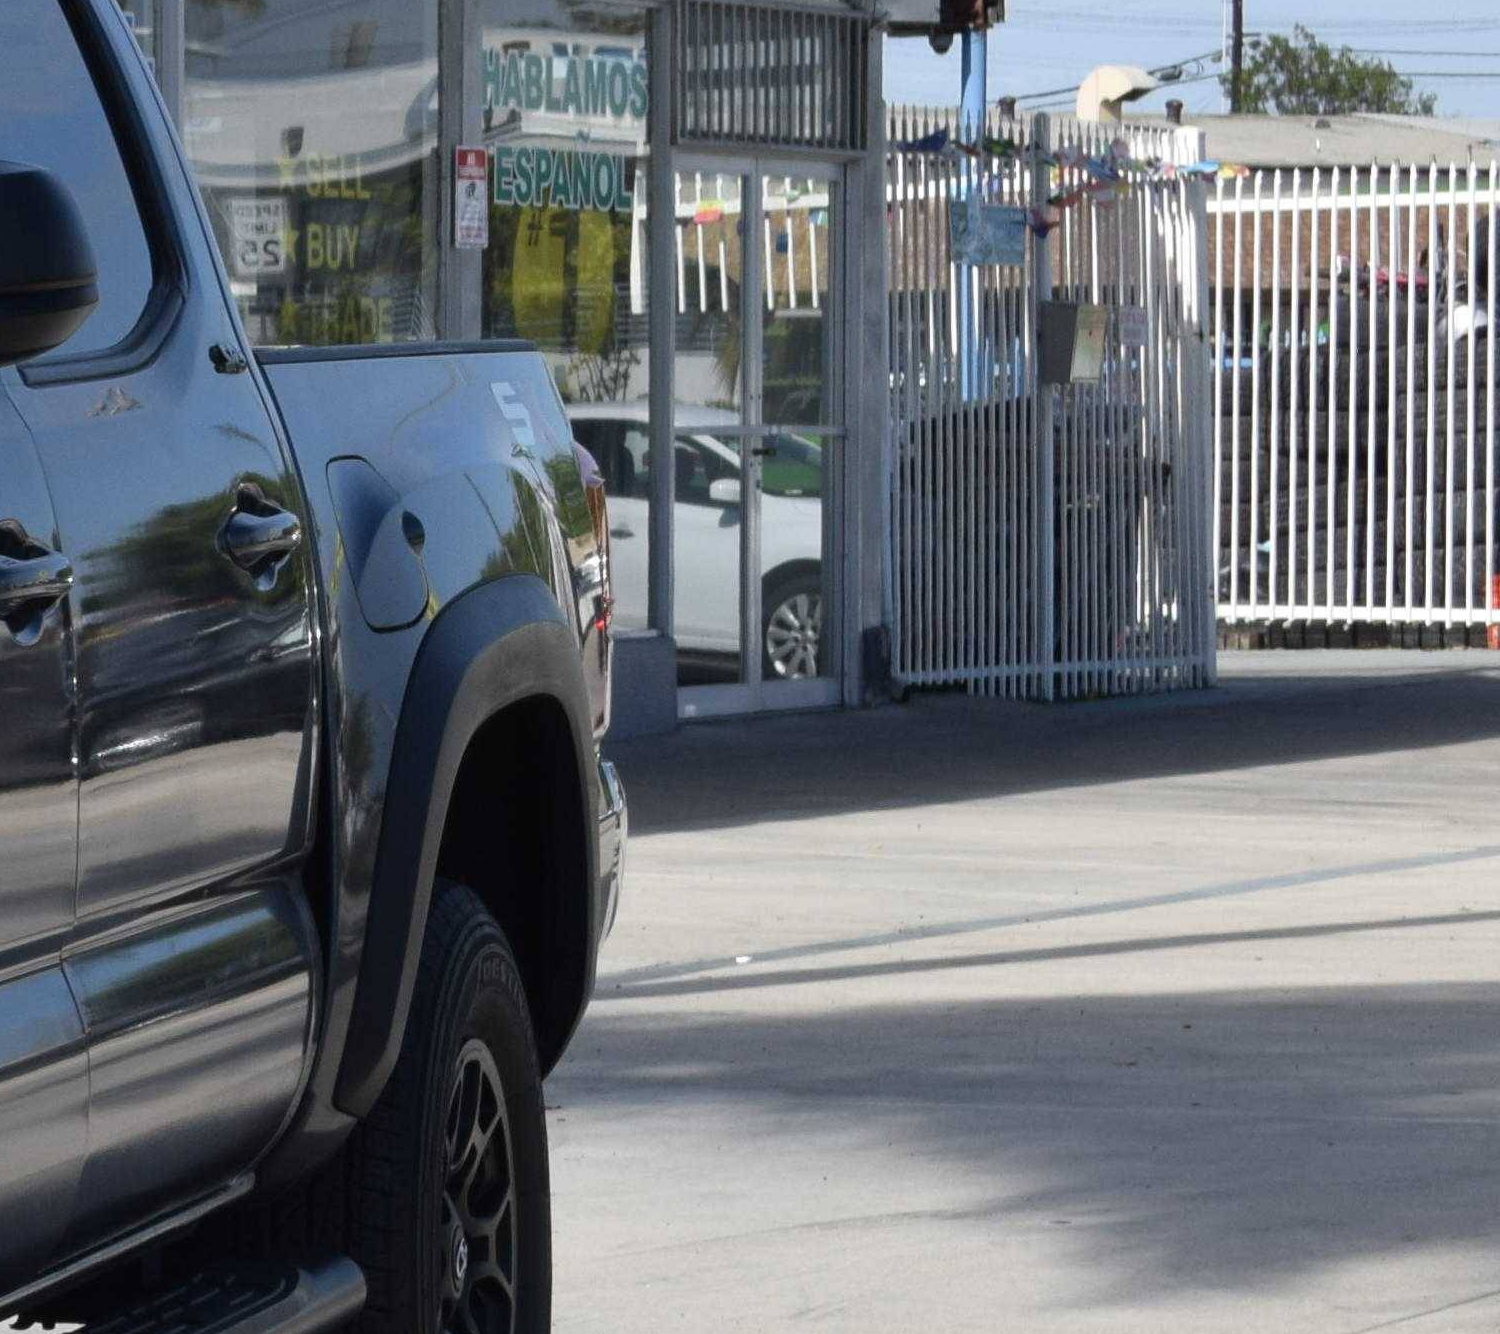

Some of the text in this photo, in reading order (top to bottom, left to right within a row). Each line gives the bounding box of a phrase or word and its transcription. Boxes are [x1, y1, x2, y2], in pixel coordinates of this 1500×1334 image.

[477, 46, 649, 118] HABLAMOS
[493, 128, 634, 212] ESPAÑOL
[306, 221, 361, 269] BUY
